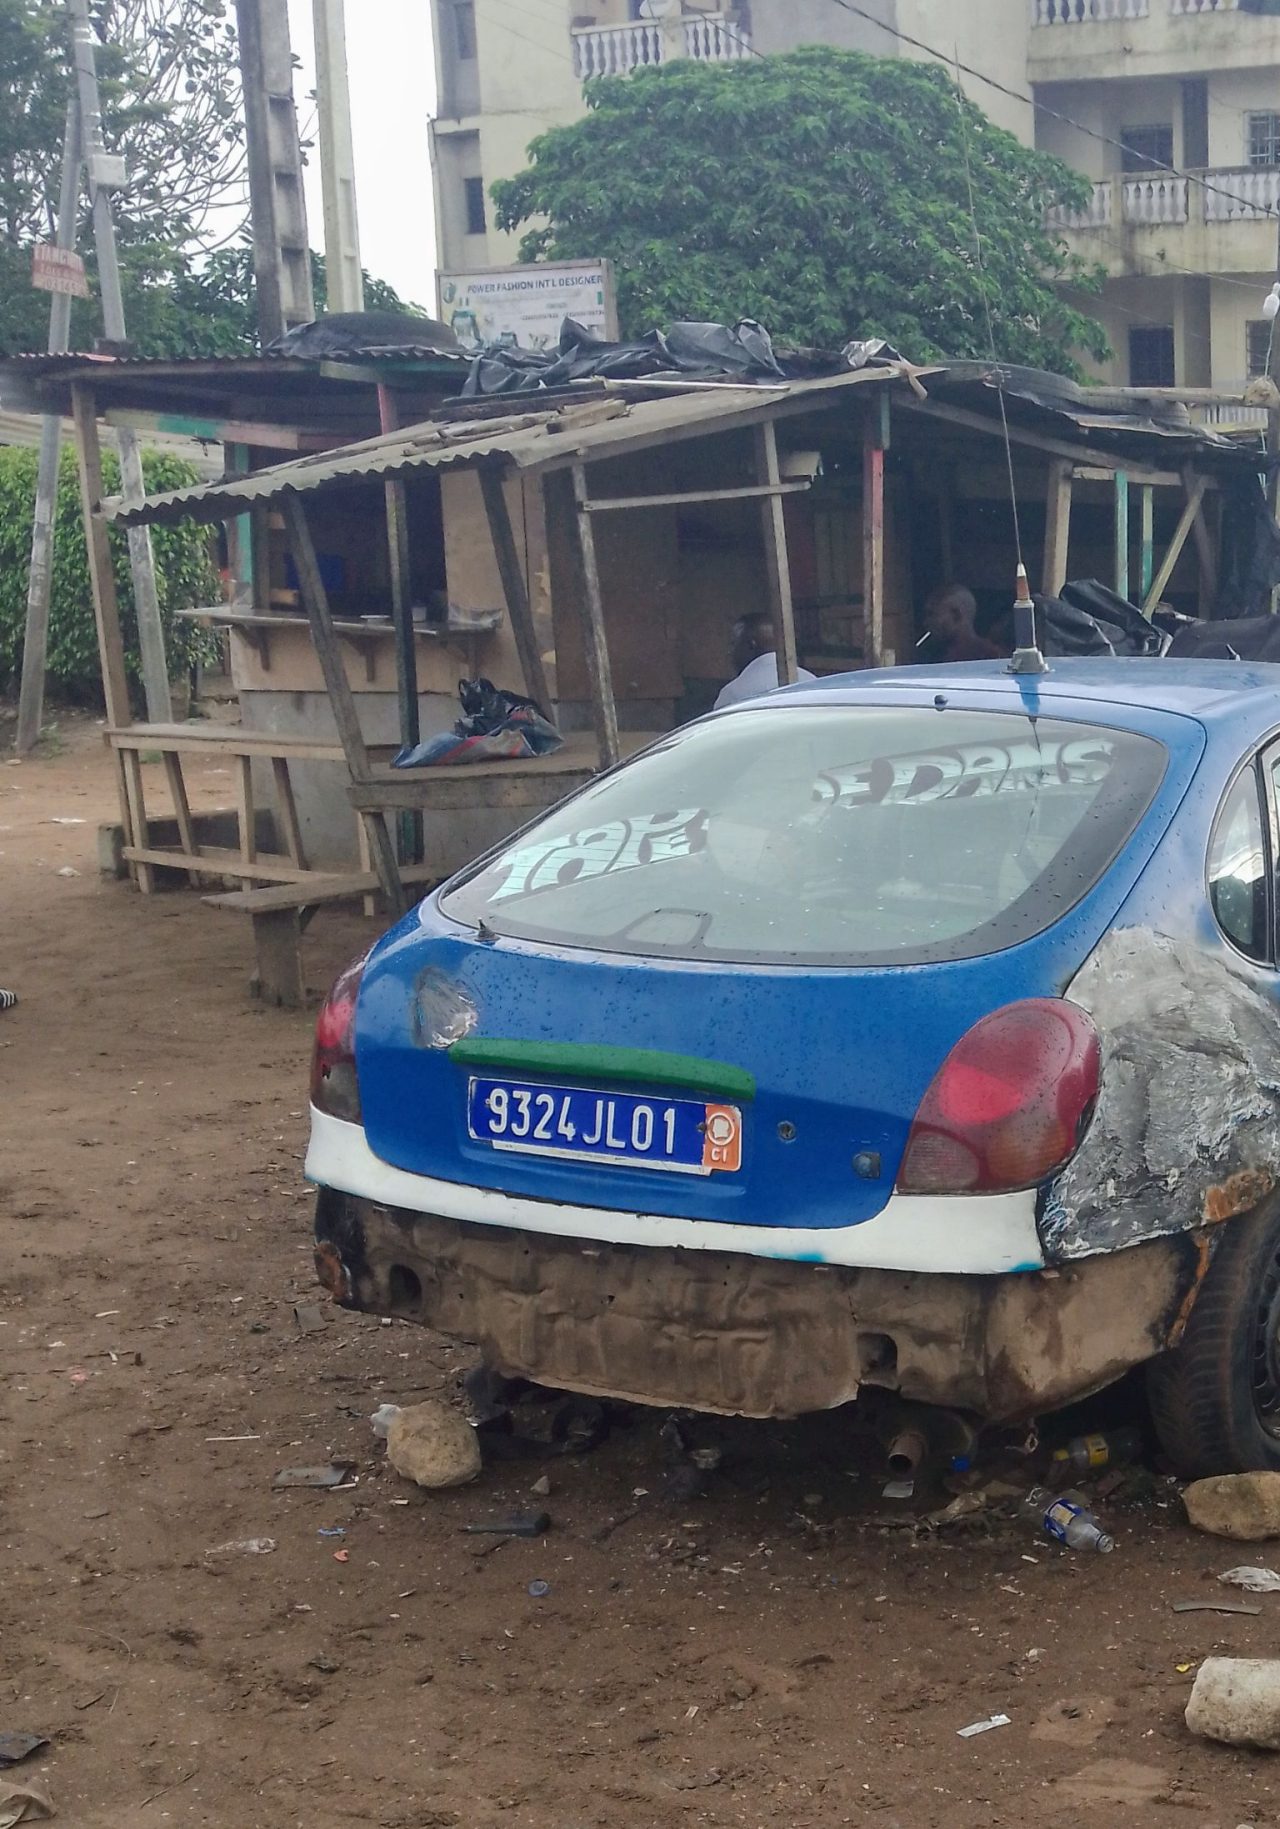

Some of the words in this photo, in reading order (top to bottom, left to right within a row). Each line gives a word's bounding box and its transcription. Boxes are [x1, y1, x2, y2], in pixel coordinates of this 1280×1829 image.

[496, 281, 534, 292] FASHION
[488, 1087, 677, 1155] 9324JL01
[711, 1147, 728, 1164] CI
